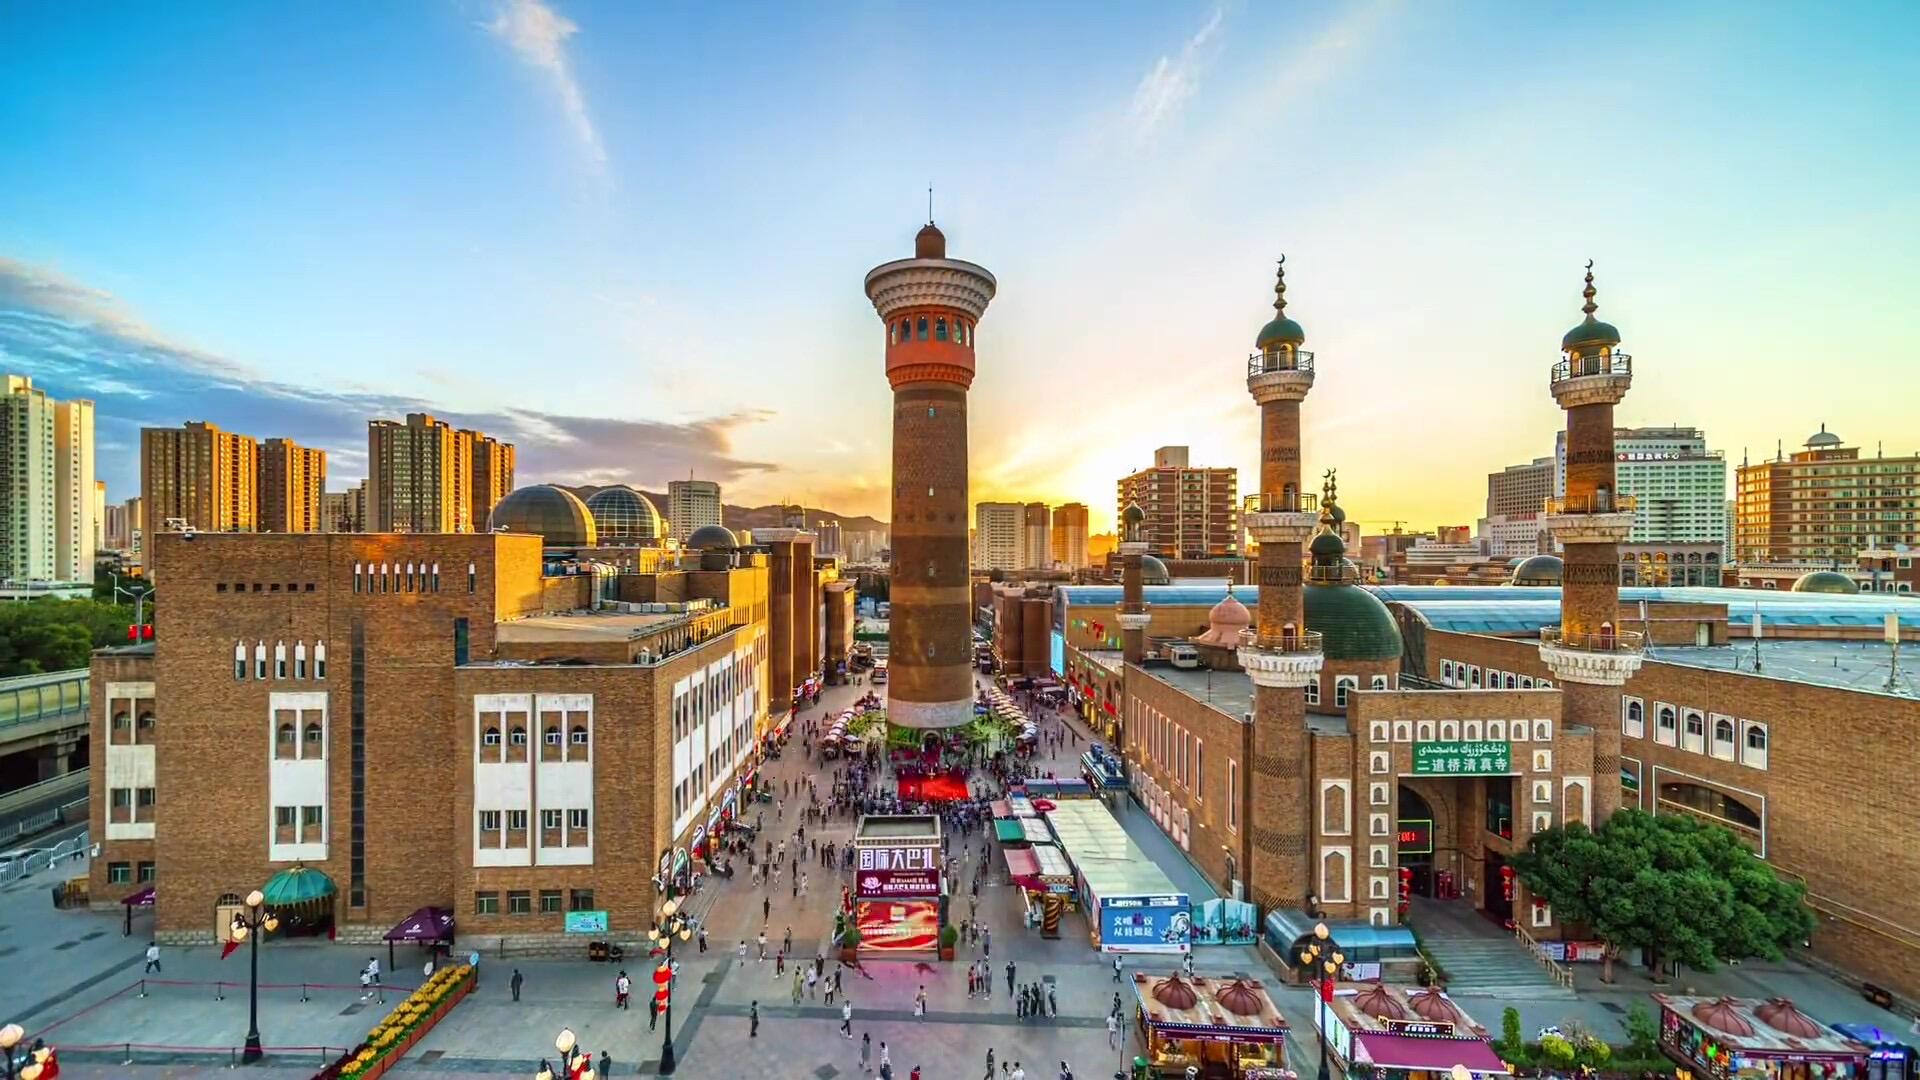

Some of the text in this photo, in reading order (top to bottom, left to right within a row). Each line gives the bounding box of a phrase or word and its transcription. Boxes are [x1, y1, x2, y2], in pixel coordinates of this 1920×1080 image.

[1417, 758, 1508, 772] 二道桥清真寺
[860, 848, 936, 870] 国际大巴扎
